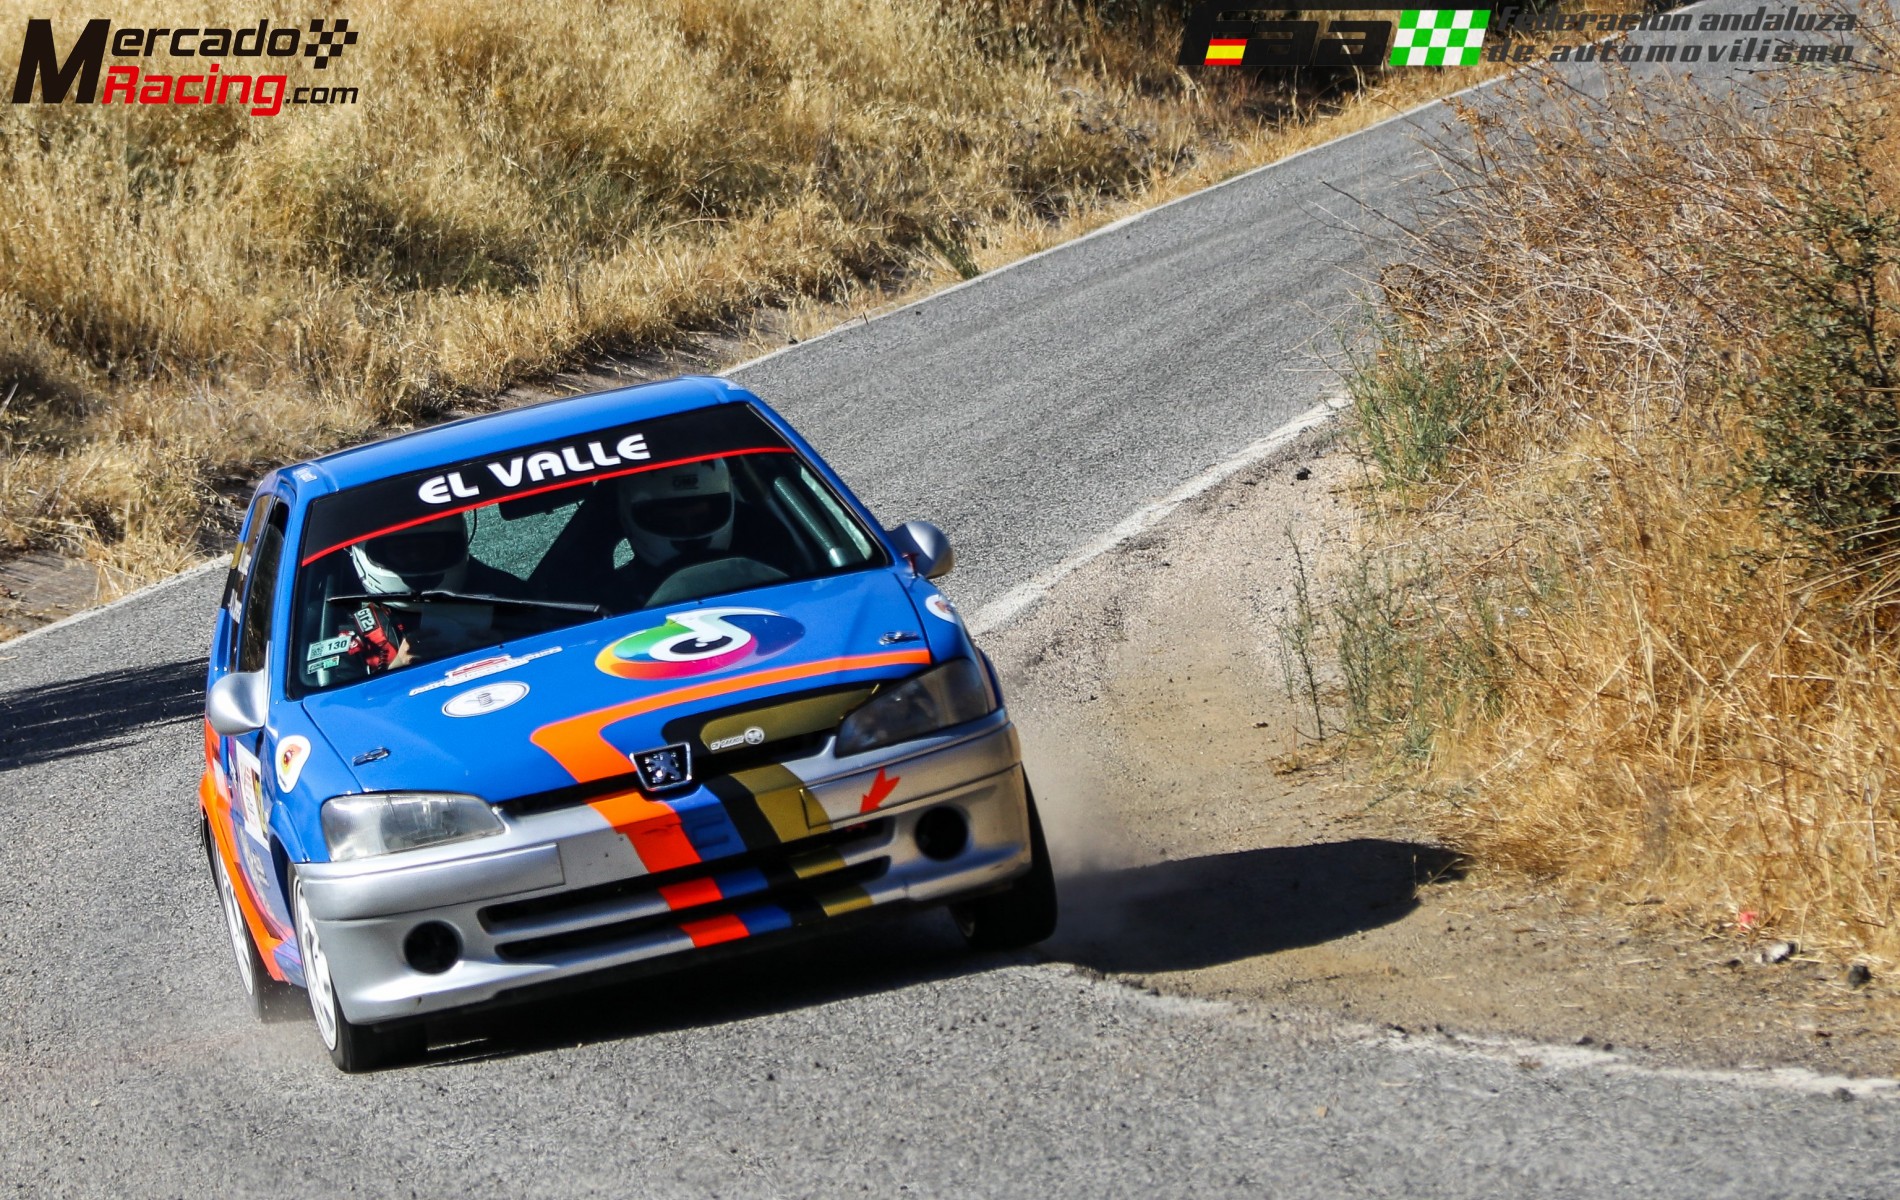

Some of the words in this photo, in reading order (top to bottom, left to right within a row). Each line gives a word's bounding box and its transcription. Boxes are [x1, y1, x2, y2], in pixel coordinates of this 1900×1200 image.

[418, 471, 480, 504] EL
[487, 433, 651, 487] VALLE
[327, 640, 348, 651] 130
